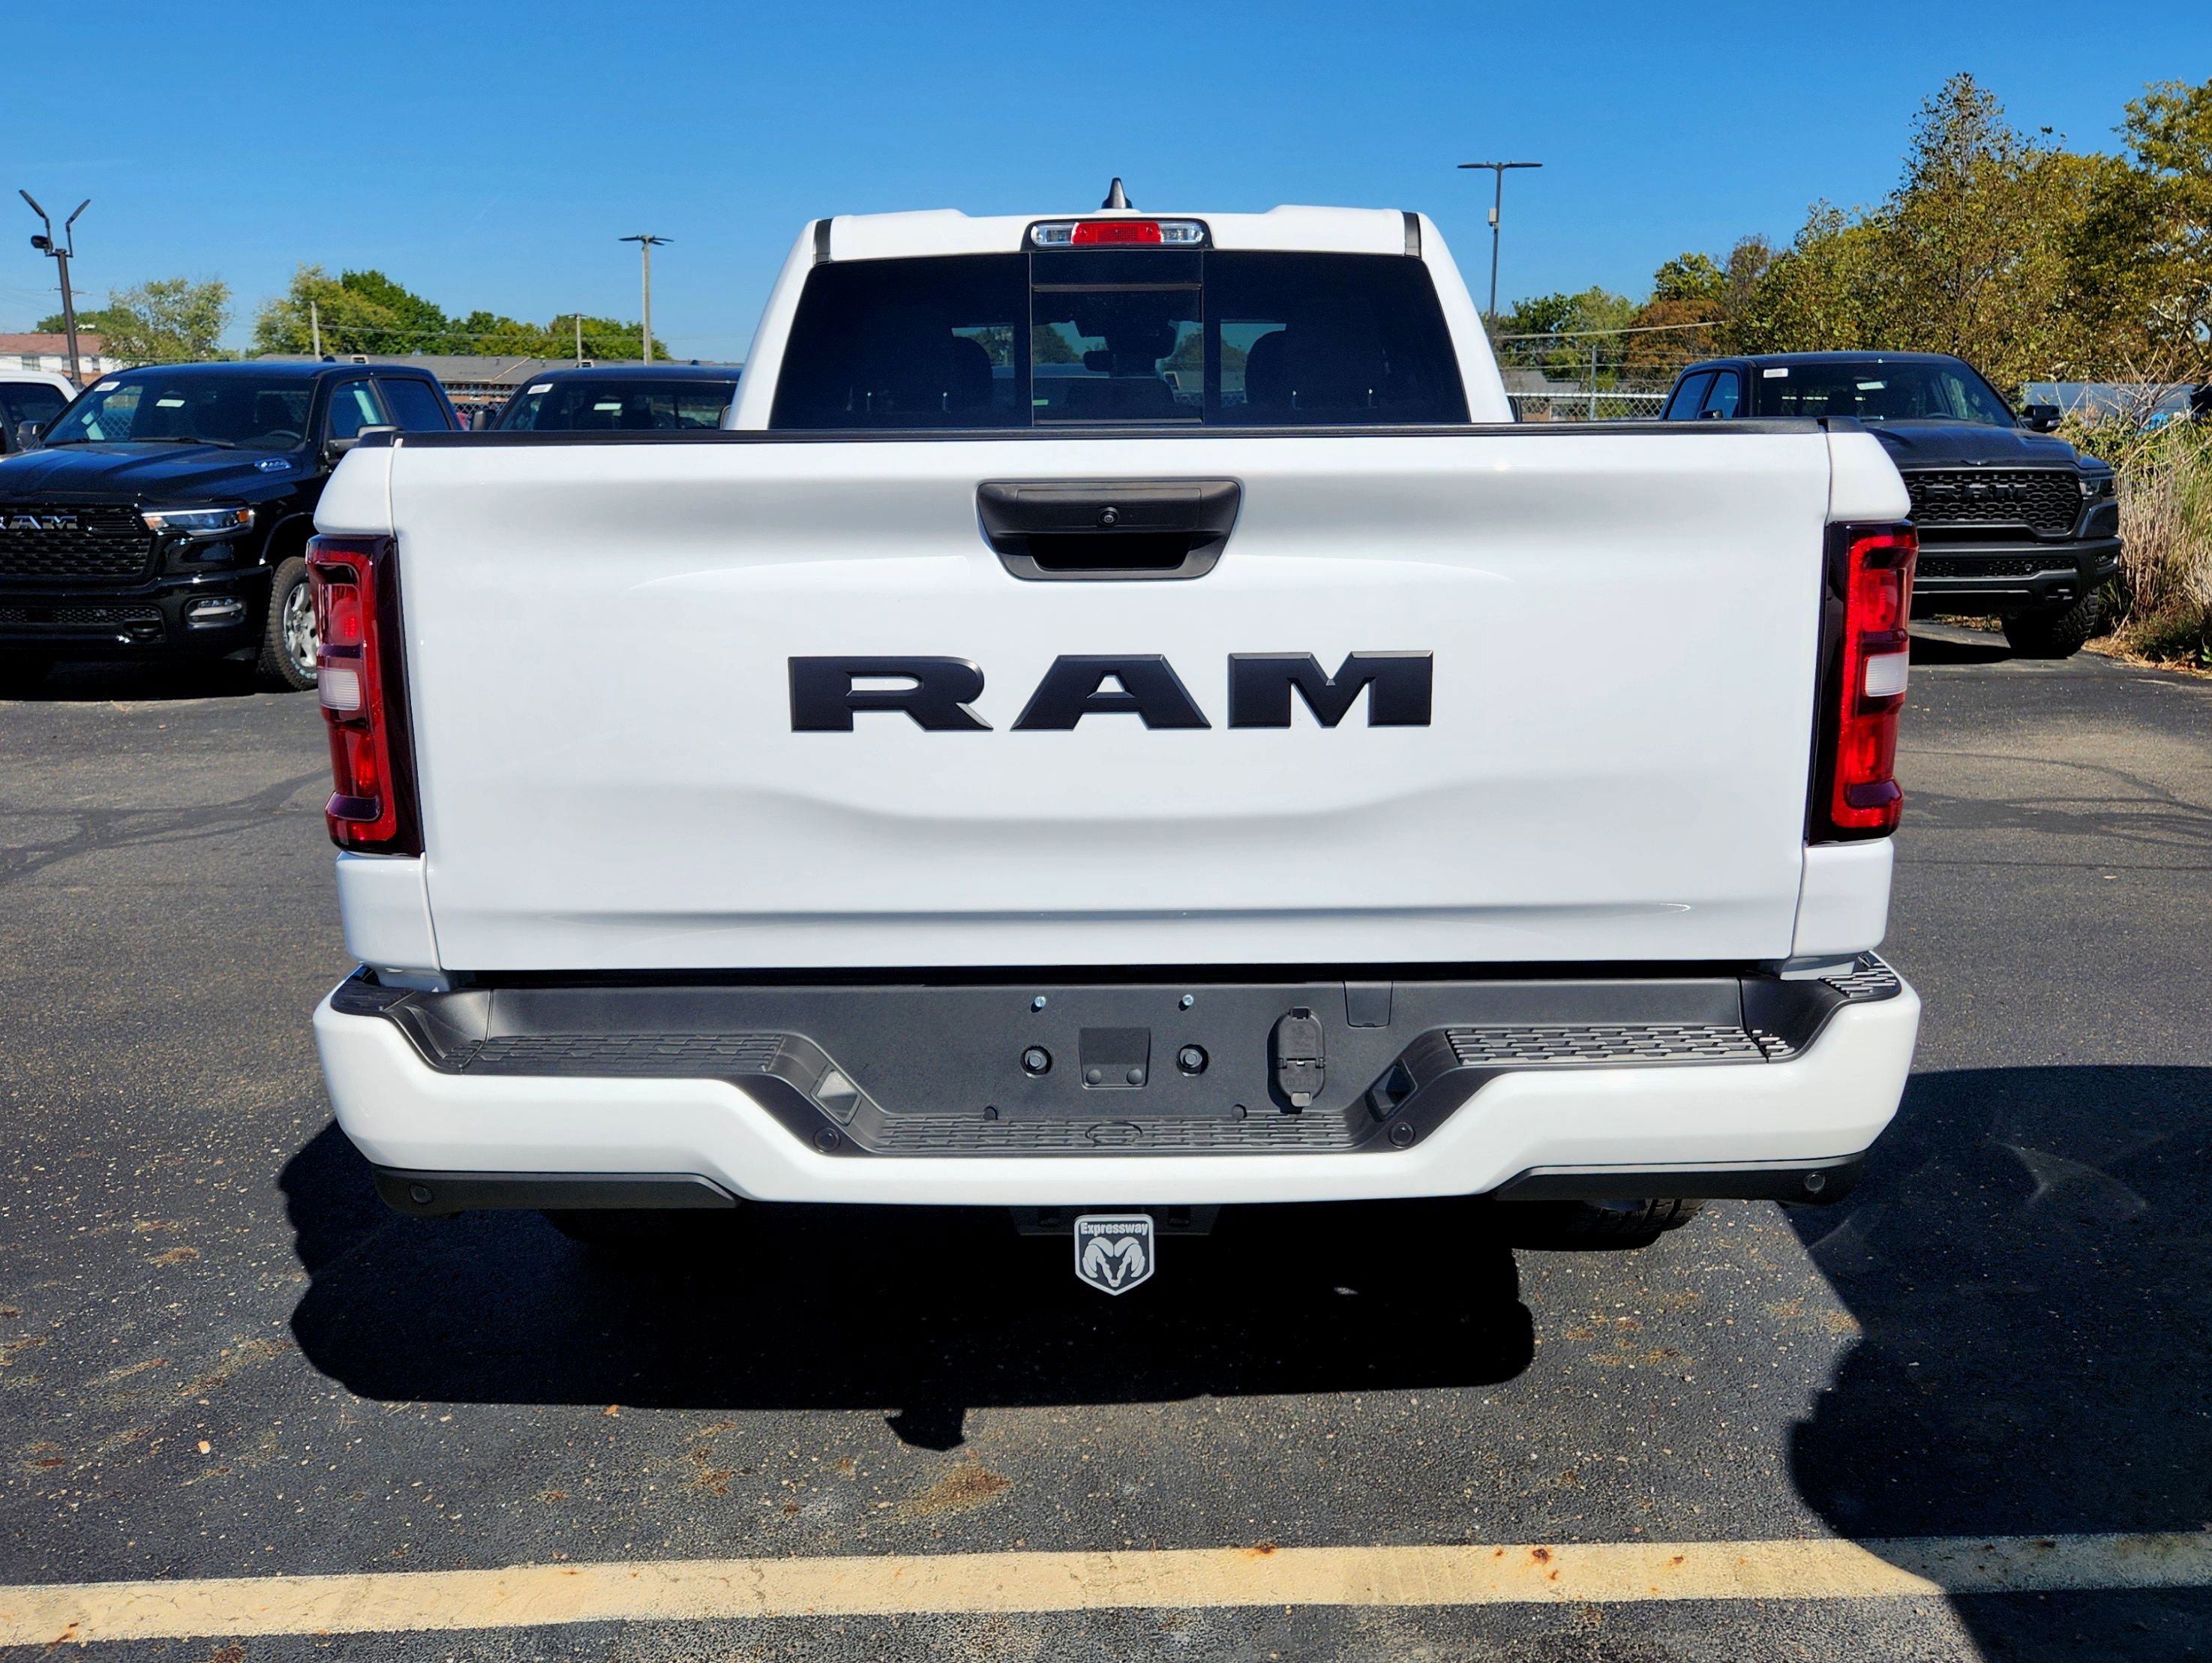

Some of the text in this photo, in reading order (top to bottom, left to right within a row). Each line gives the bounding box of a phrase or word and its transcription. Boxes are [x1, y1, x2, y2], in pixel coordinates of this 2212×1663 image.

[0, 515, 78, 530] AM
[788, 650, 1433, 731] RAM
[1080, 1222, 1148, 1237] Expressway
